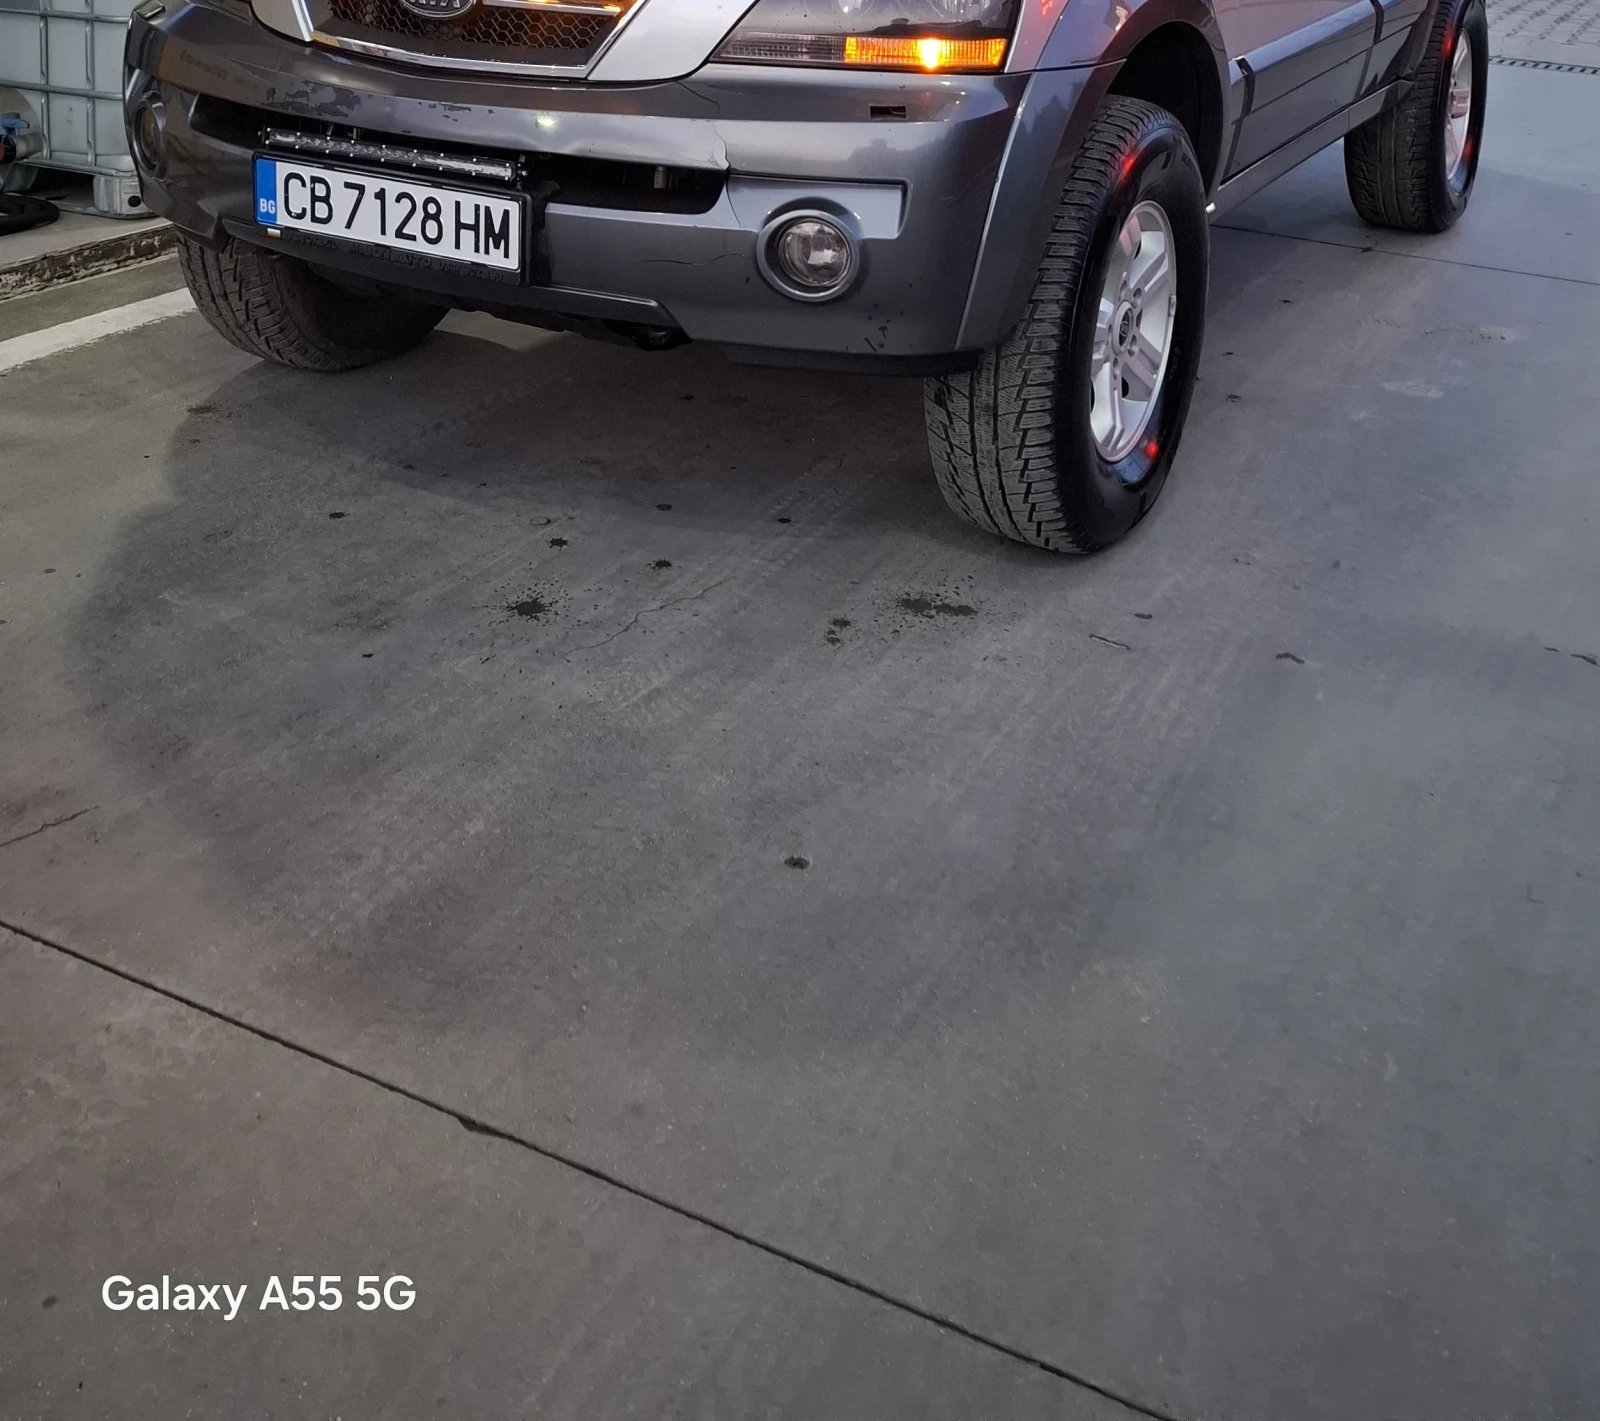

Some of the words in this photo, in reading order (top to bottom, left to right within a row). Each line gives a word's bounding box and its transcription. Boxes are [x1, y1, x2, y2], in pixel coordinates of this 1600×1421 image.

[259, 197, 276, 215] BG
[283, 172, 333, 225] CB
[343, 181, 444, 245] 7128
[454, 200, 510, 259] HM
